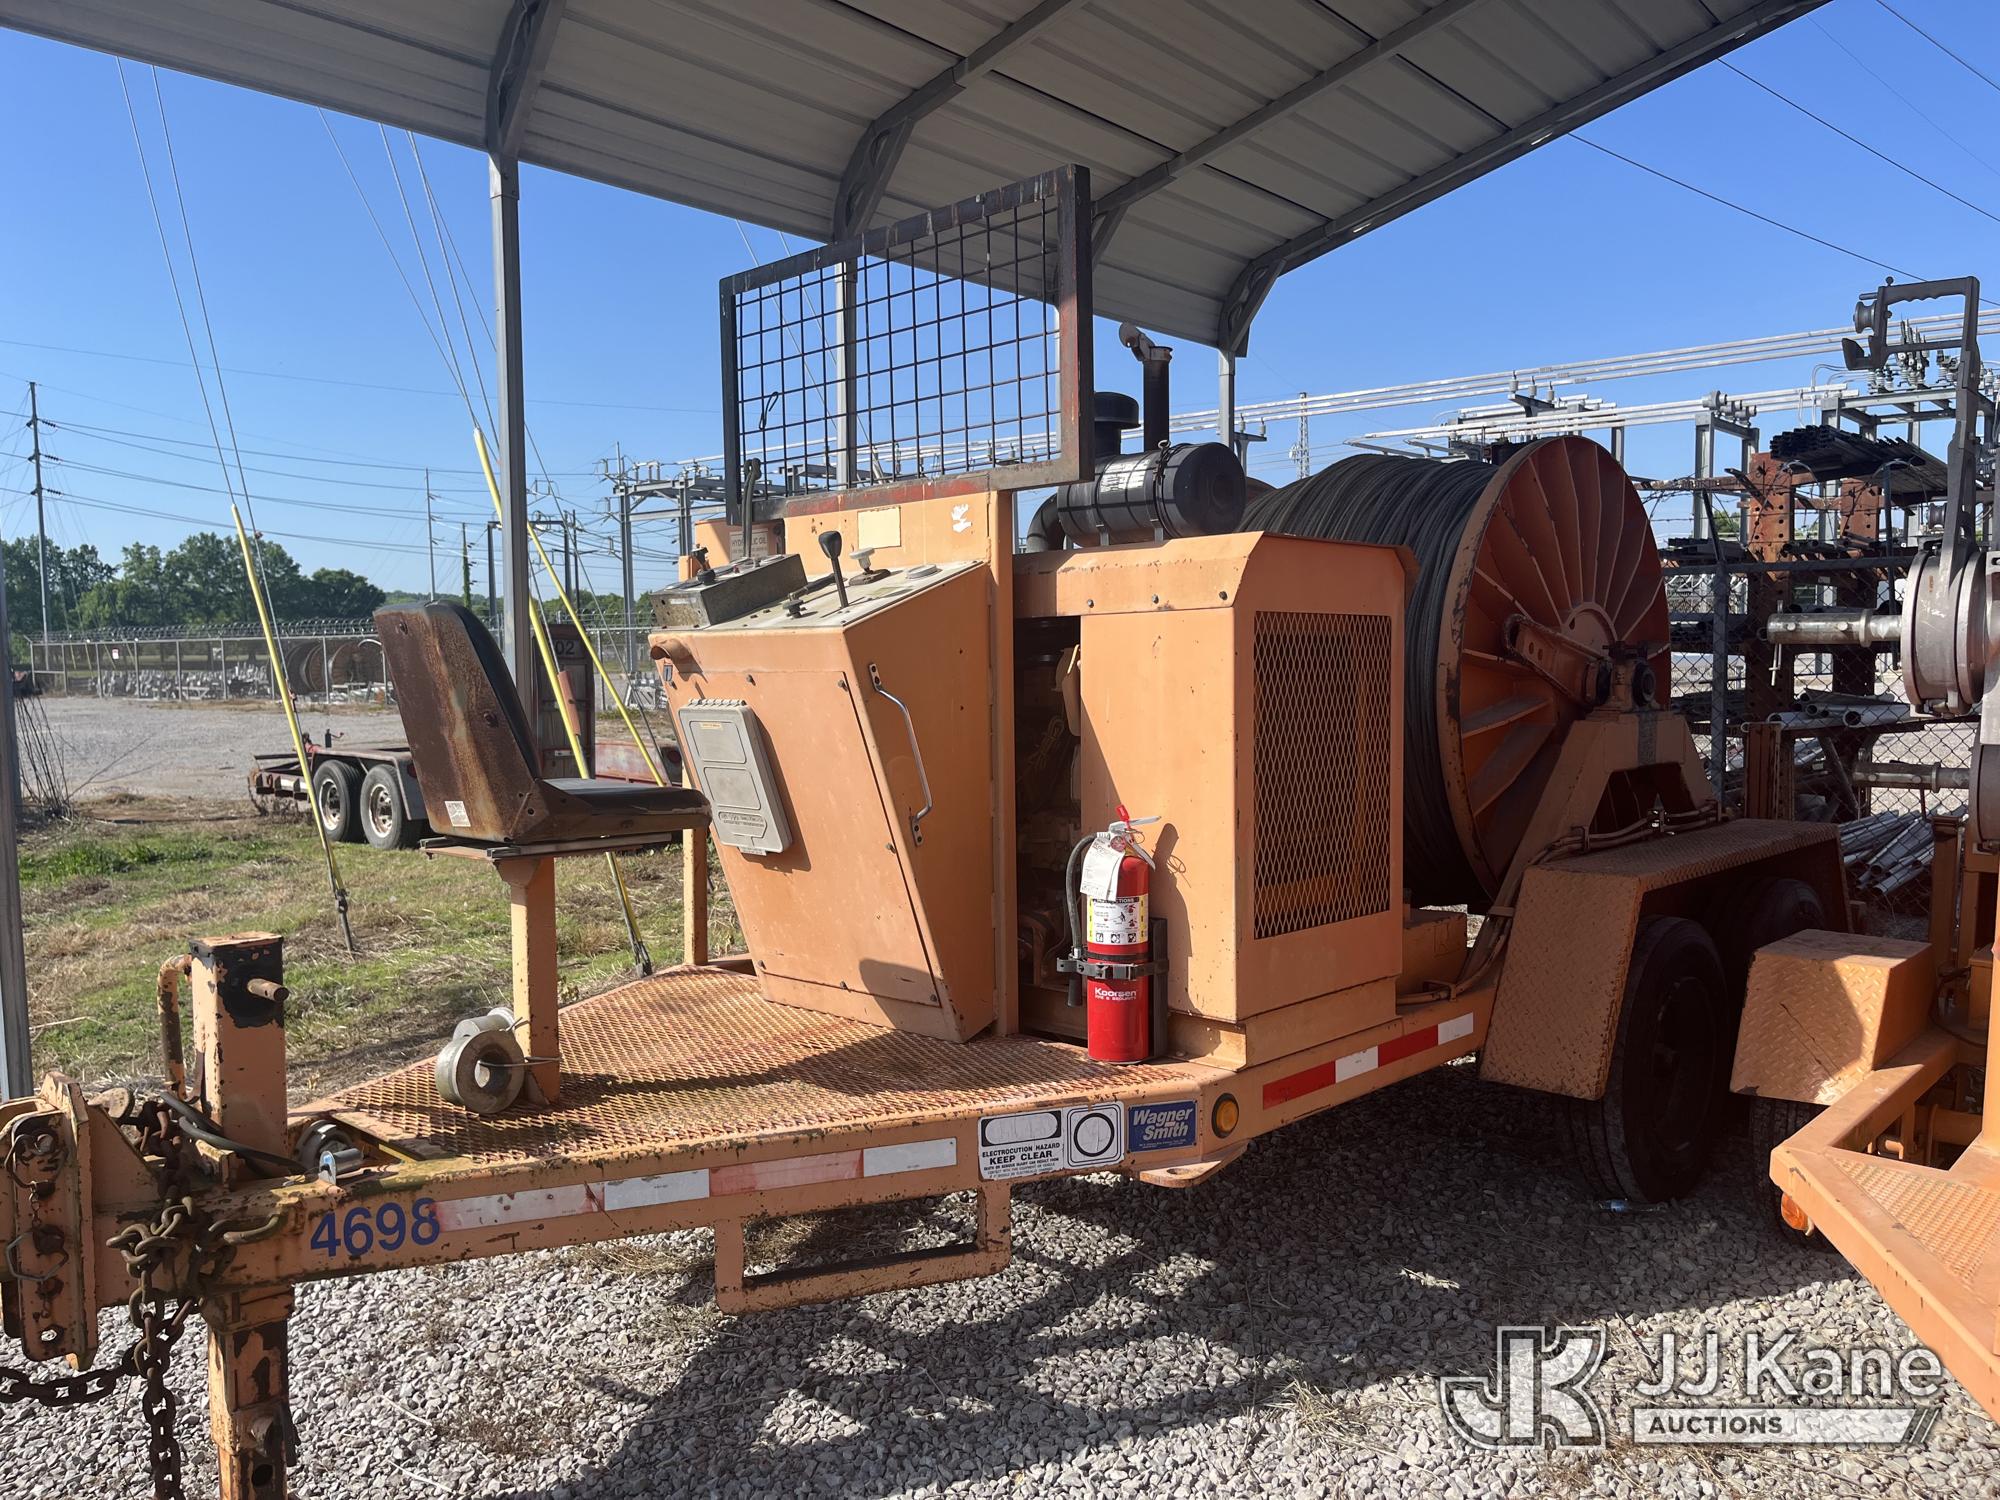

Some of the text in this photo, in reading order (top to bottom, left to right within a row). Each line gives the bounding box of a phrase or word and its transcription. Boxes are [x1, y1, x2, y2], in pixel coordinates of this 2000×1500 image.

[1095, 987, 1136, 996] Koorsen
[1133, 1108, 1194, 1127] Wagner
[1142, 1121, 1188, 1141] Smith
[982, 1142, 1060, 1158] ELECTROCUTION HAZARD
[989, 1150, 1053, 1165] KEEP CLEAR
[310, 1196, 441, 1257] 4698
